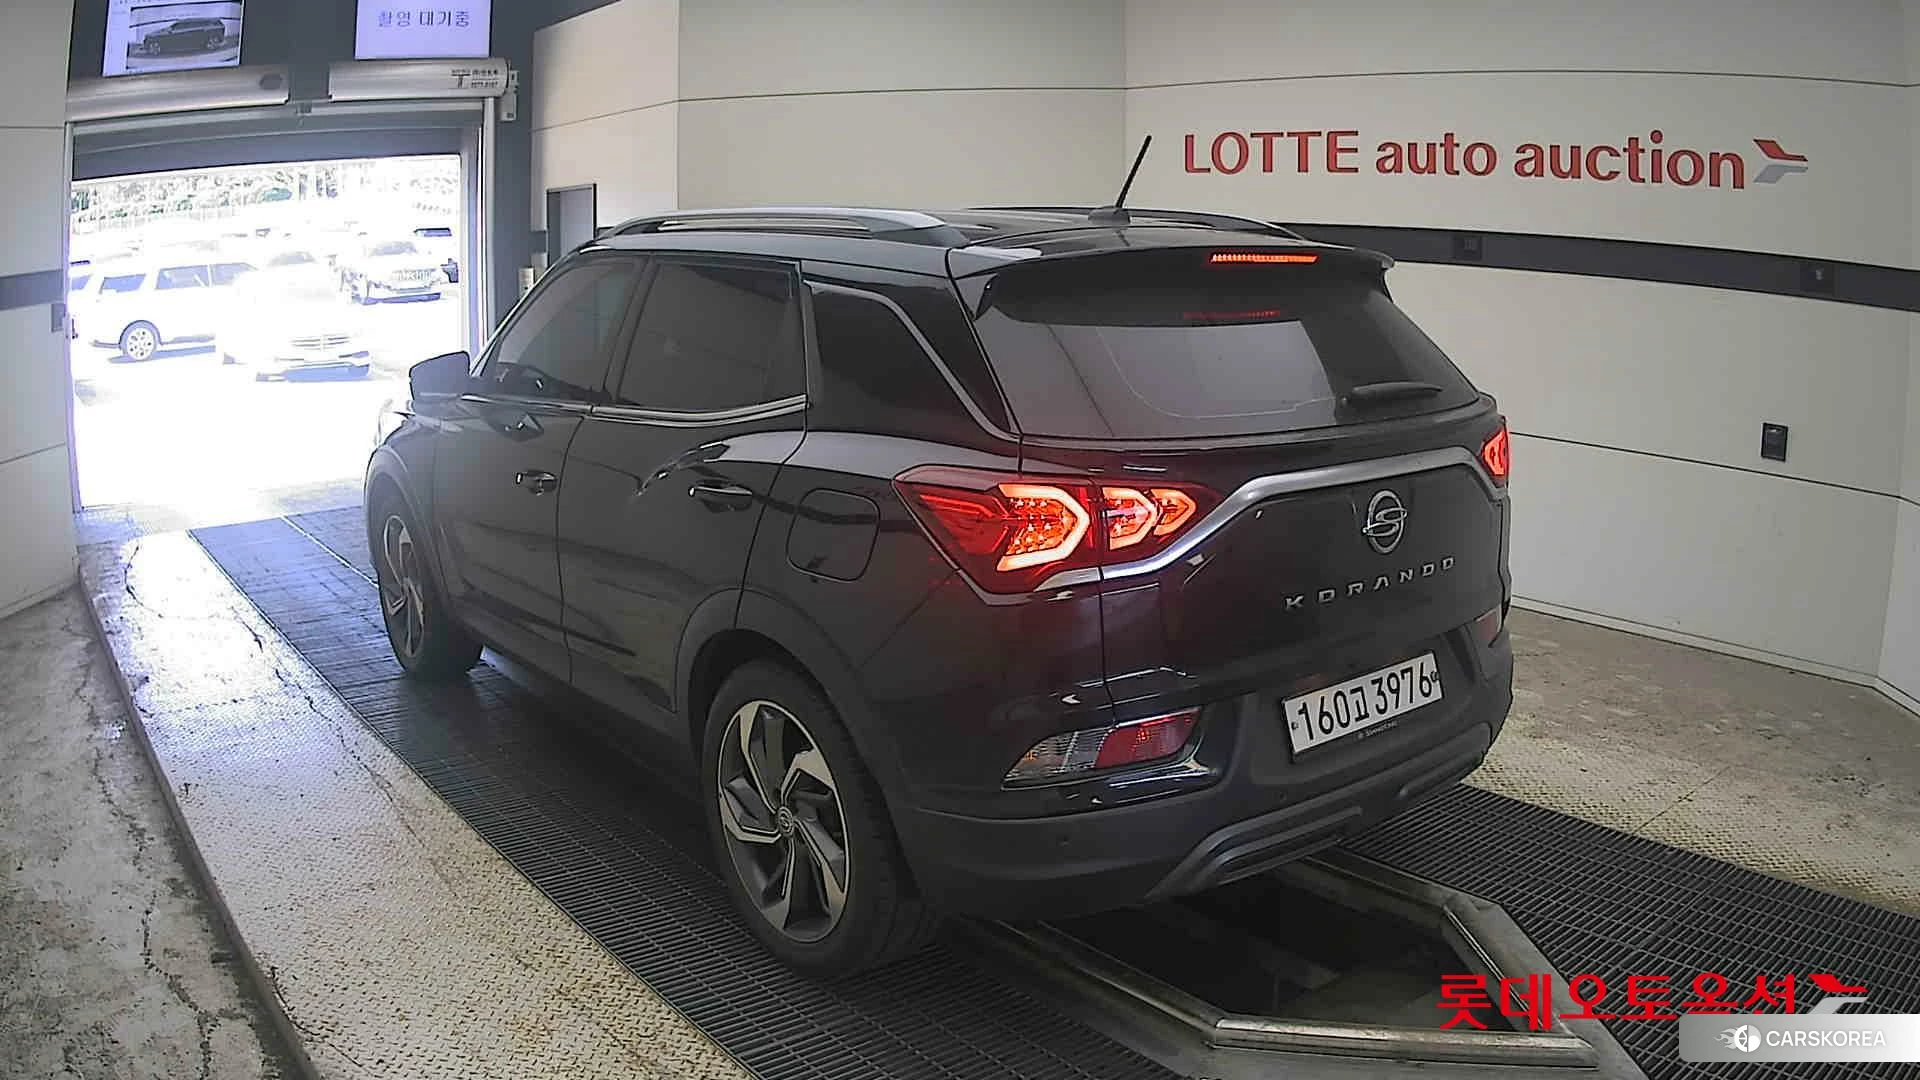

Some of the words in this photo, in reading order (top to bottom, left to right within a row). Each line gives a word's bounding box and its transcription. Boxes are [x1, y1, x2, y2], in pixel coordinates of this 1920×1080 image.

[419, 10, 469, 28] 대기중
[1184, 130, 1359, 174] LOTTE
[1376, 132, 1498, 176] auto
[1514, 129, 1746, 190] auction
[1284, 556, 1454, 609] KORANDO
